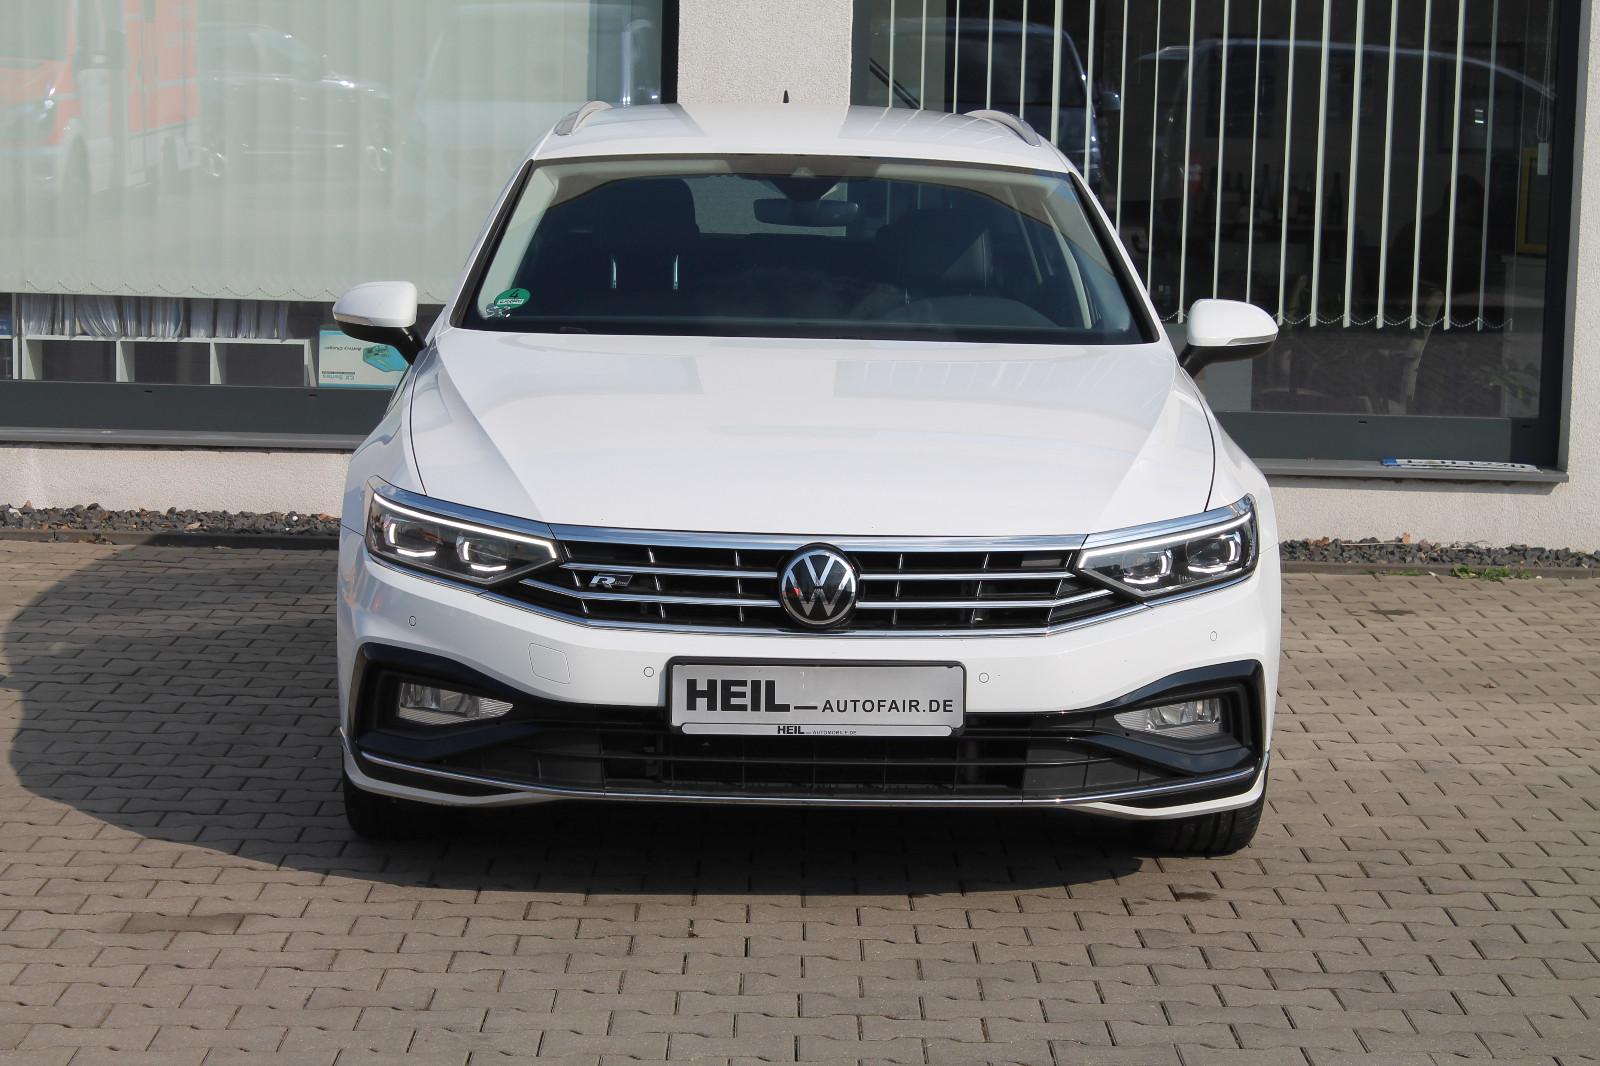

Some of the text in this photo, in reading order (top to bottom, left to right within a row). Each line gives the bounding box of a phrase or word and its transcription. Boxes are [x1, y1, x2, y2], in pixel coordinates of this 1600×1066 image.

[508, 289, 519, 298] 4
[821, 698, 954, 713] AUTOFAIR.DE
[777, 725, 805, 735] HEIL
